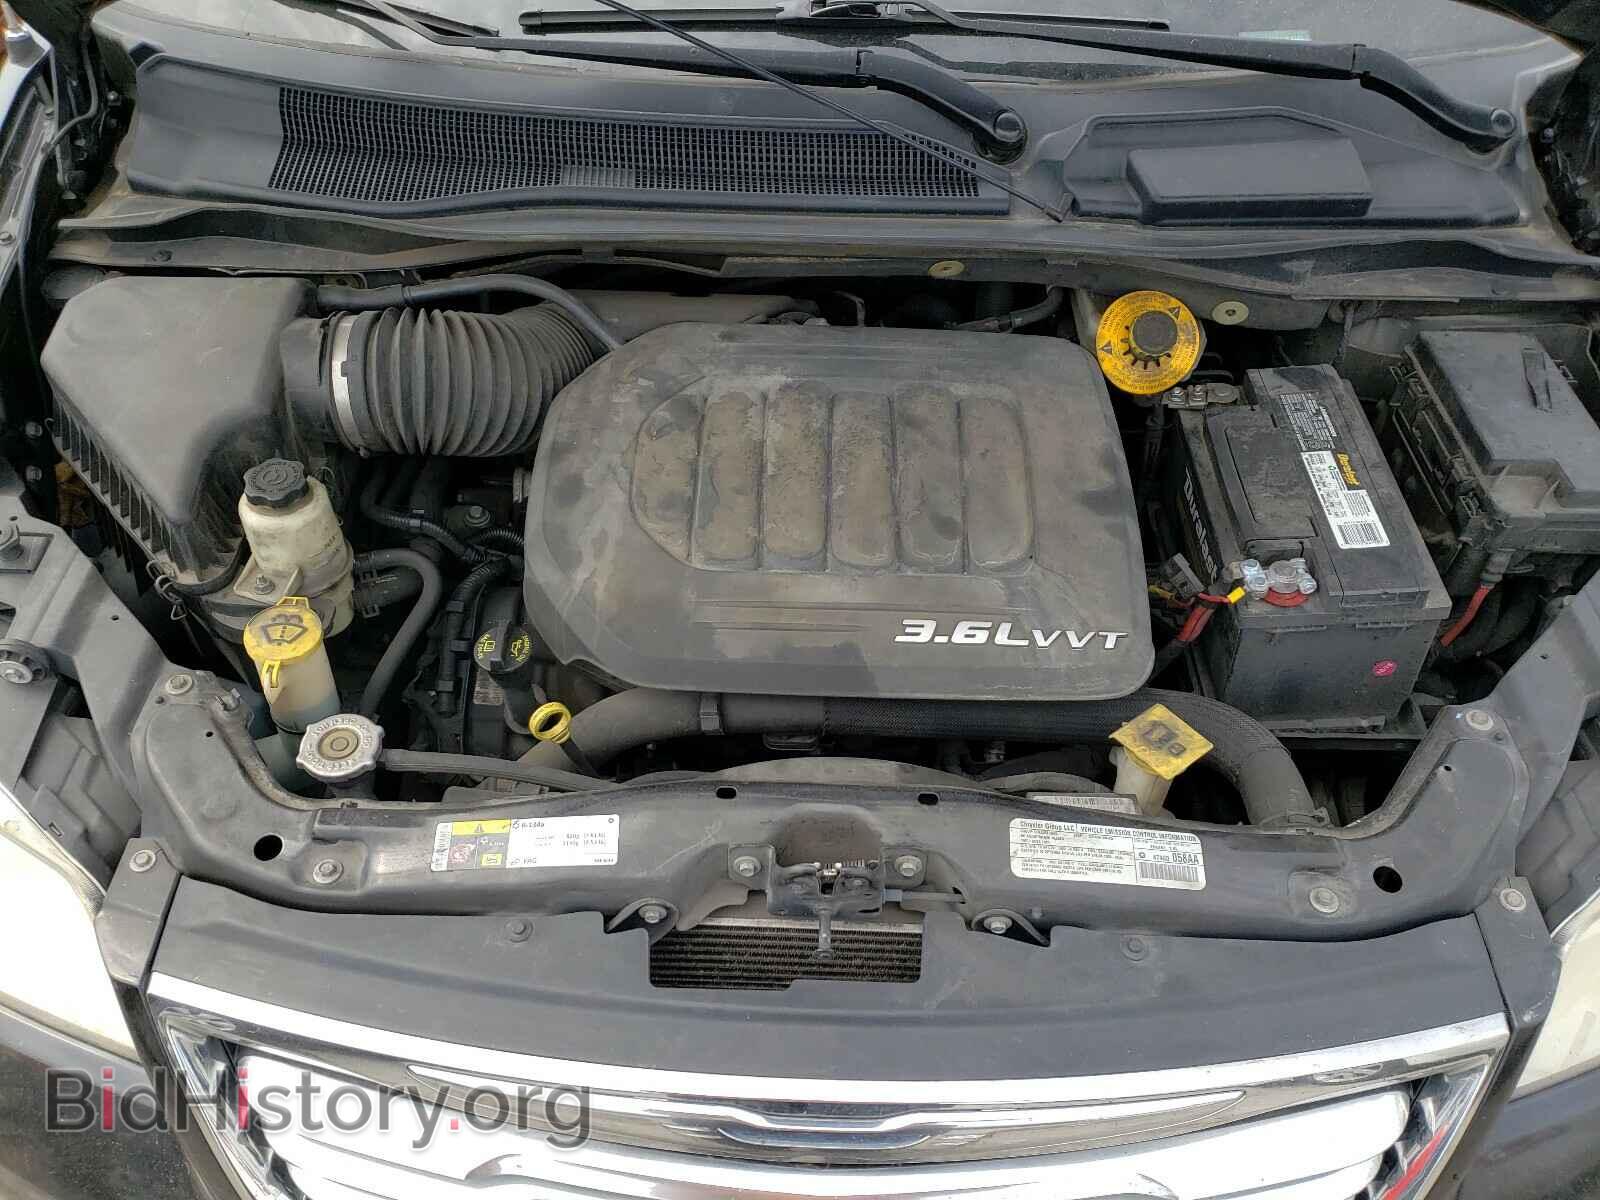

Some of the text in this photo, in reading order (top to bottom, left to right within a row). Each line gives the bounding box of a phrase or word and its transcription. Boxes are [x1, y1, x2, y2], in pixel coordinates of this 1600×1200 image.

[1183, 464, 1218, 585] Duralast
[893, 618, 1129, 651] 3.6L VVT
[1045, 822, 1062, 832] Group
[1063, 824, 1075, 832] LLC
[1080, 826, 1104, 834] VEHICLE
[1104, 828, 1131, 837] EMISSION
[1132, 830, 1157, 839] CONTROL
[1157, 832, 1197, 842] INFORMATION
[1172, 852, 1199, 865] 058AA
